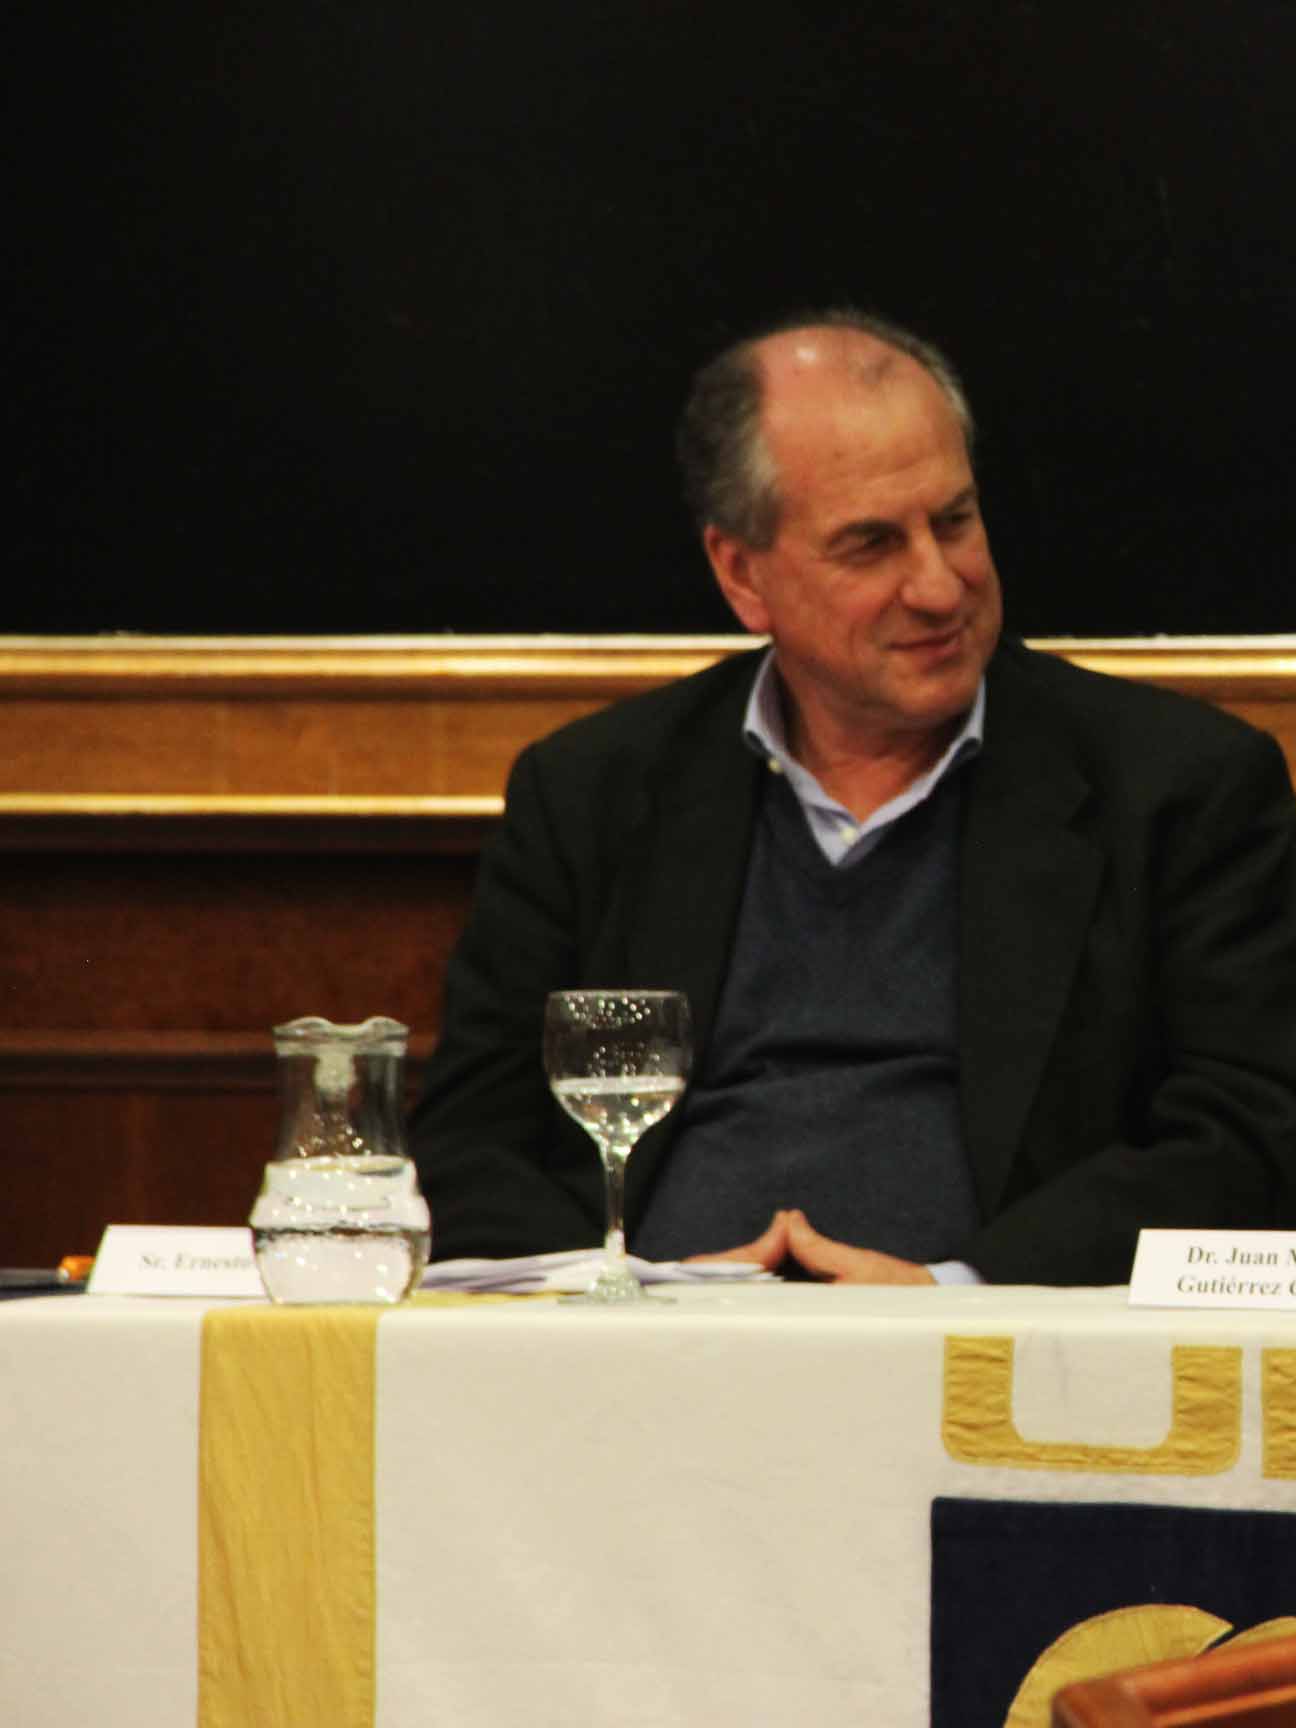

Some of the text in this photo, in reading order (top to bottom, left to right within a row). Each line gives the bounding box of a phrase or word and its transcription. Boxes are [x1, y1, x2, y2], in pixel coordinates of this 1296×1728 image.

[1186, 1245, 1218, 1265] Dr.
[1225, 1246, 1279, 1267] Juan
[1176, 1274, 1281, 1297] Gutiérrez
